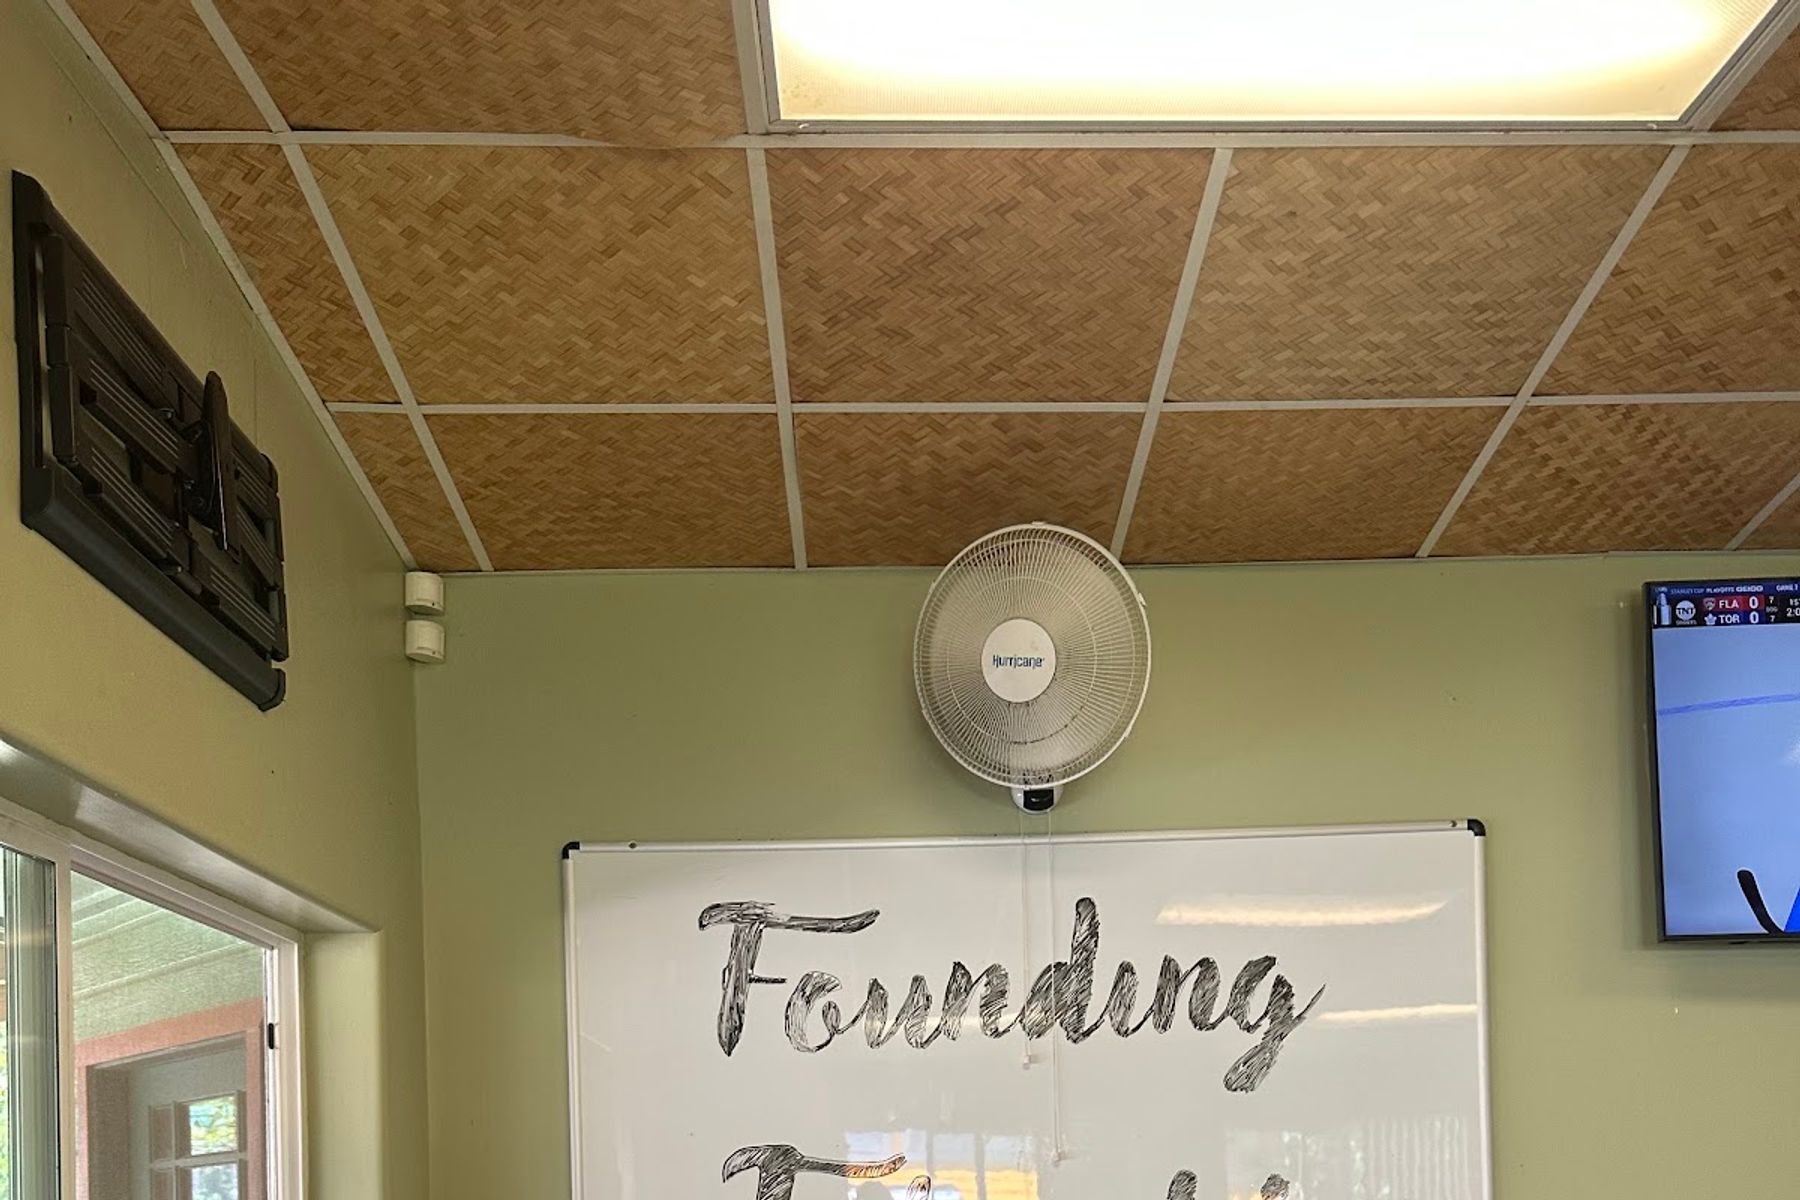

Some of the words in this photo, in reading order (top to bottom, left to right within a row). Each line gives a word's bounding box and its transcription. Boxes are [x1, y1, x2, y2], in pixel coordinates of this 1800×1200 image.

[1719, 599, 1739, 609] FLA
[1749, 596, 1759, 609] 0
[1676, 607, 1696, 615] TNT
[1719, 614, 1740, 624] TOR
[1749, 611, 1759, 624] 0
[992, 654, 1043, 669] Hurricane
[698, 897, 1326, 1093] Founding
